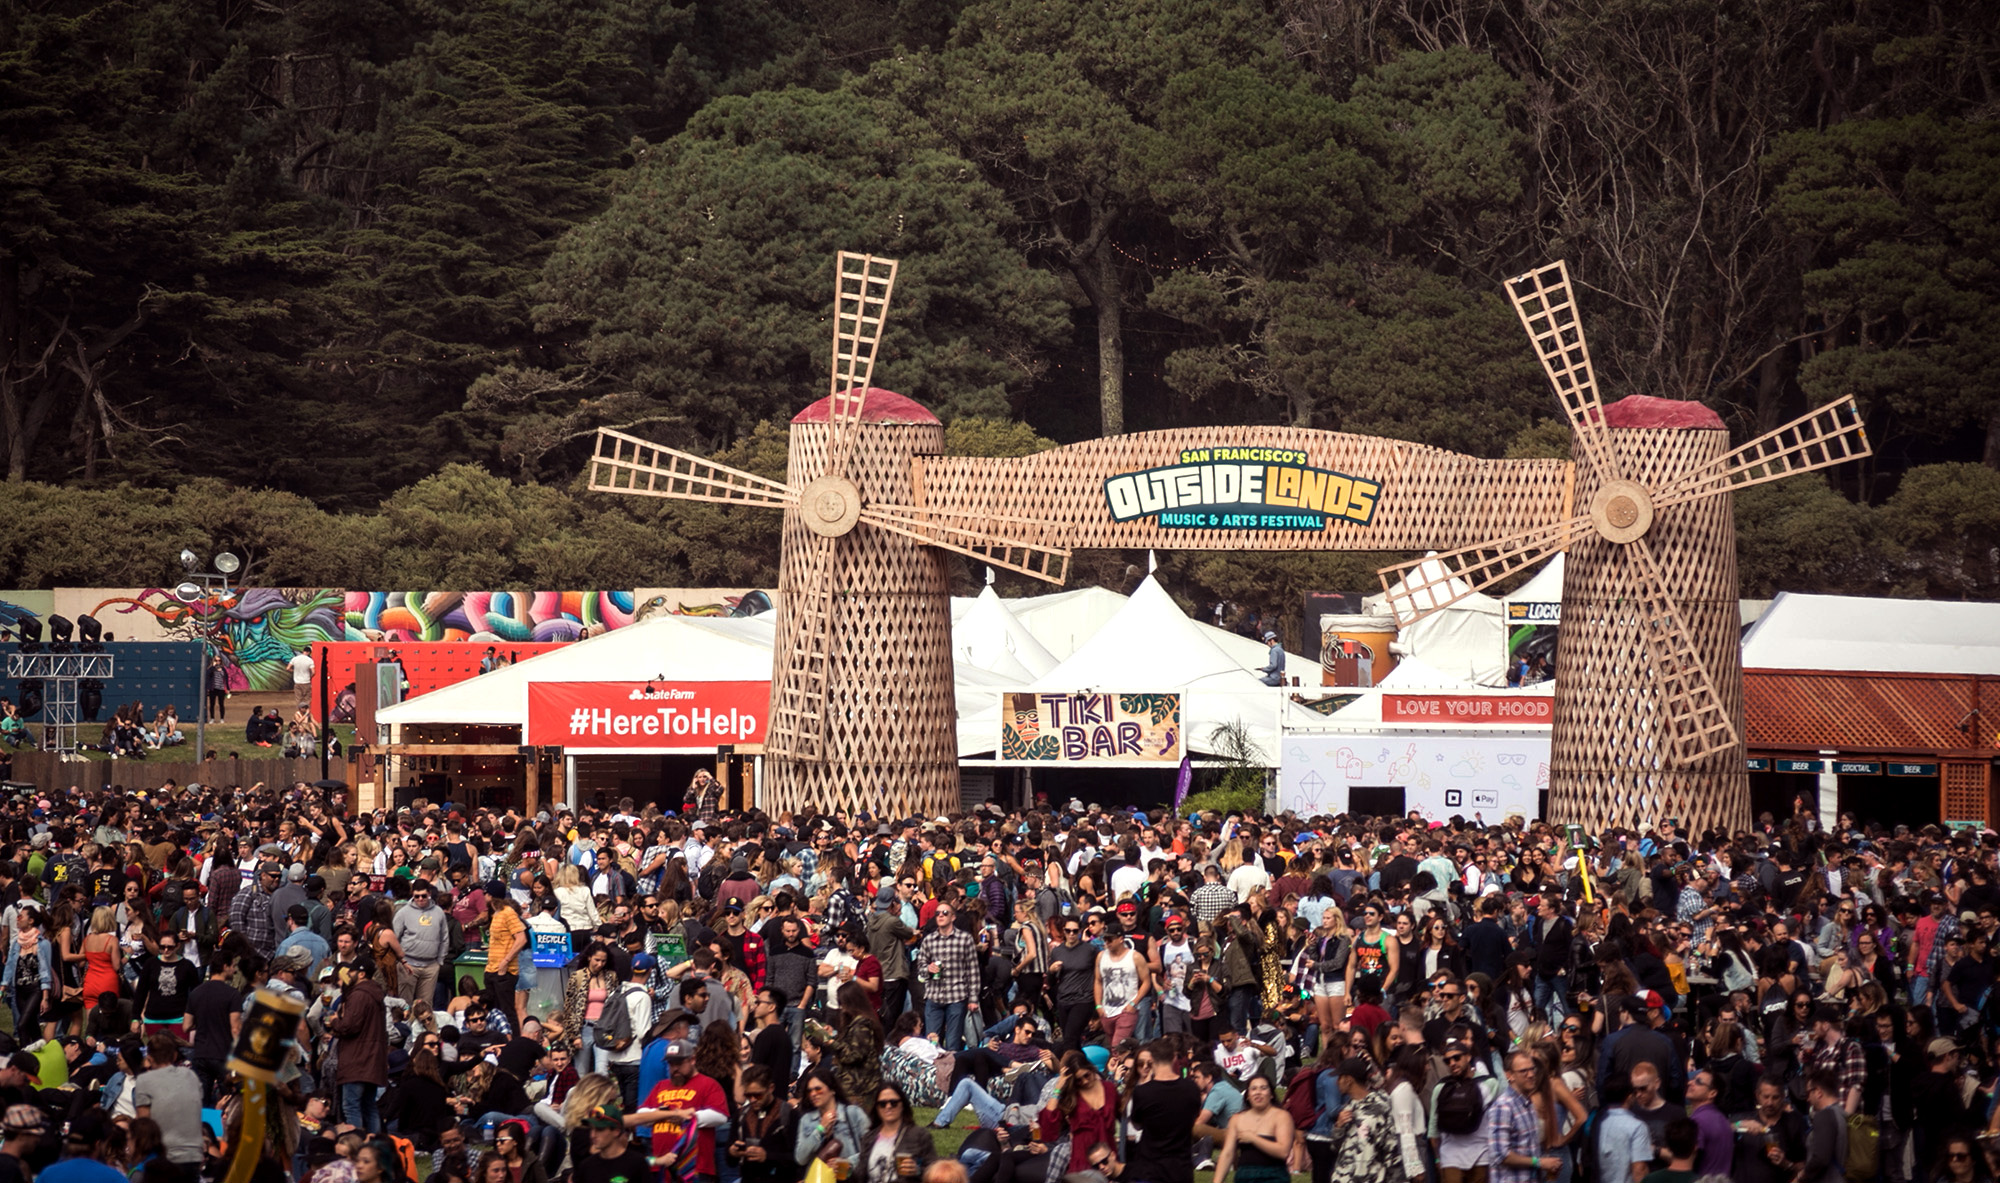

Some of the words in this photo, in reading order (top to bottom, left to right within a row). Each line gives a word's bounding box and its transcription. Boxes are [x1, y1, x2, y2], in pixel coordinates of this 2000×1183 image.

[1181, 450, 1210, 463] SAN
[1213, 449, 1307, 465] FRANCISCO'S
[1107, 464, 1265, 519] OUTSIDE
[1265, 466, 1379, 522] LANDS
[1161, 513, 1206, 526] MUSIC
[1209, 514, 1219, 526] &
[1222, 514, 1258, 527] ARTS
[1261, 514, 1324, 528] FESTIVAL
[1528, 603, 1561, 619] LOCK
[1041, 693, 1114, 728] TIKI
[1396, 700, 1440, 716] LOVE
[1446, 701, 1493, 716] YOUR
[1498, 702, 1549, 717] HOOD
[569, 707, 757, 740] #HereToHelp
[1062, 721, 1144, 761] BAR
[1791, 762, 1809, 771] BEER
[1841, 764, 1872, 773] COCKTAIL
[1903, 765, 1921, 774] BEER
[1481, 794, 1495, 804] Pay
[537, 934, 567, 945] RECYCLE
[1223, 1054, 1246, 1069] USA
